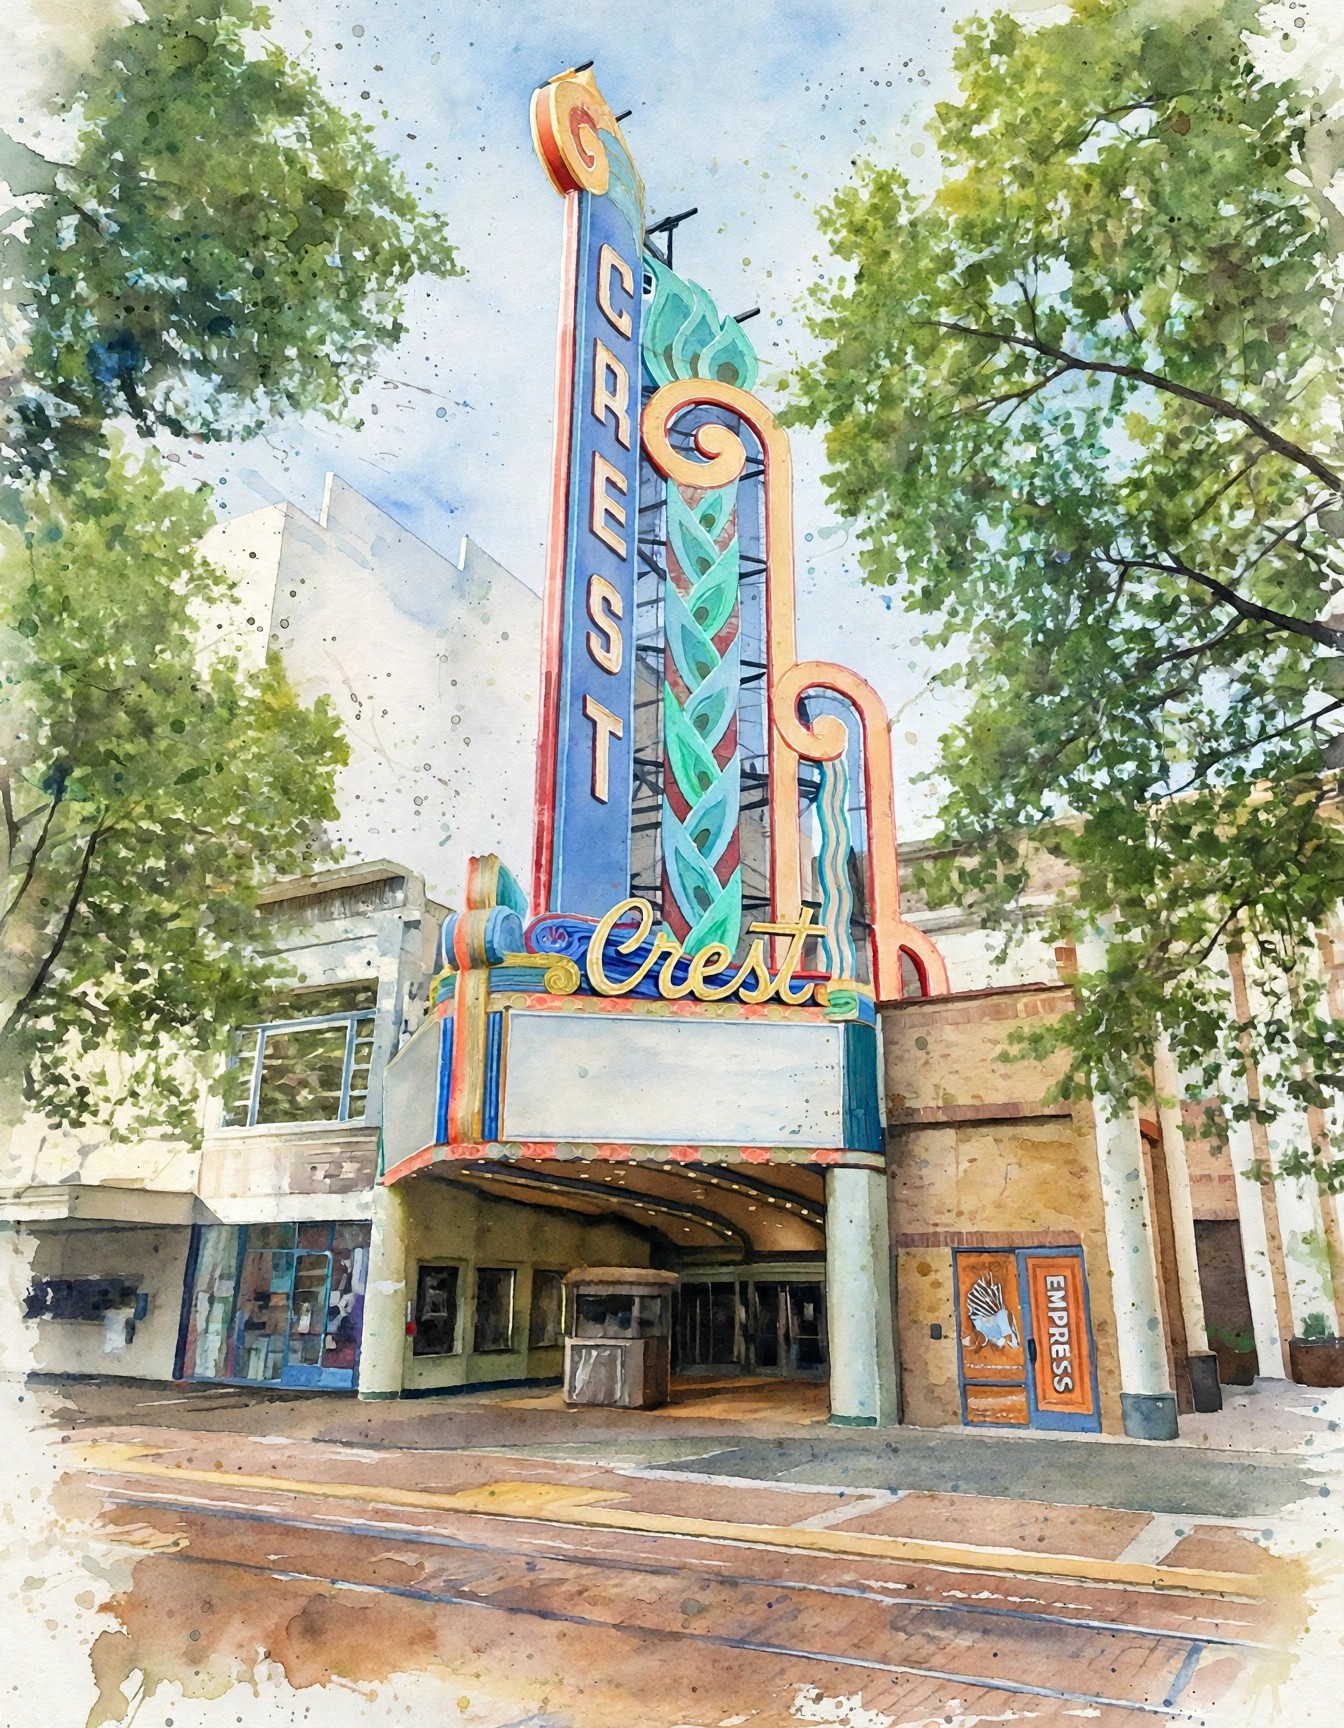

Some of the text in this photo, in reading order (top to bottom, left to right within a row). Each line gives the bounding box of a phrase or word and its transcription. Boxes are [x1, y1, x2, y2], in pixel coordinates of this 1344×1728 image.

[582, 243, 635, 805] CREST
[586, 897, 828, 1004] Crest
[1045, 1275, 1073, 1393] EMPRESS
